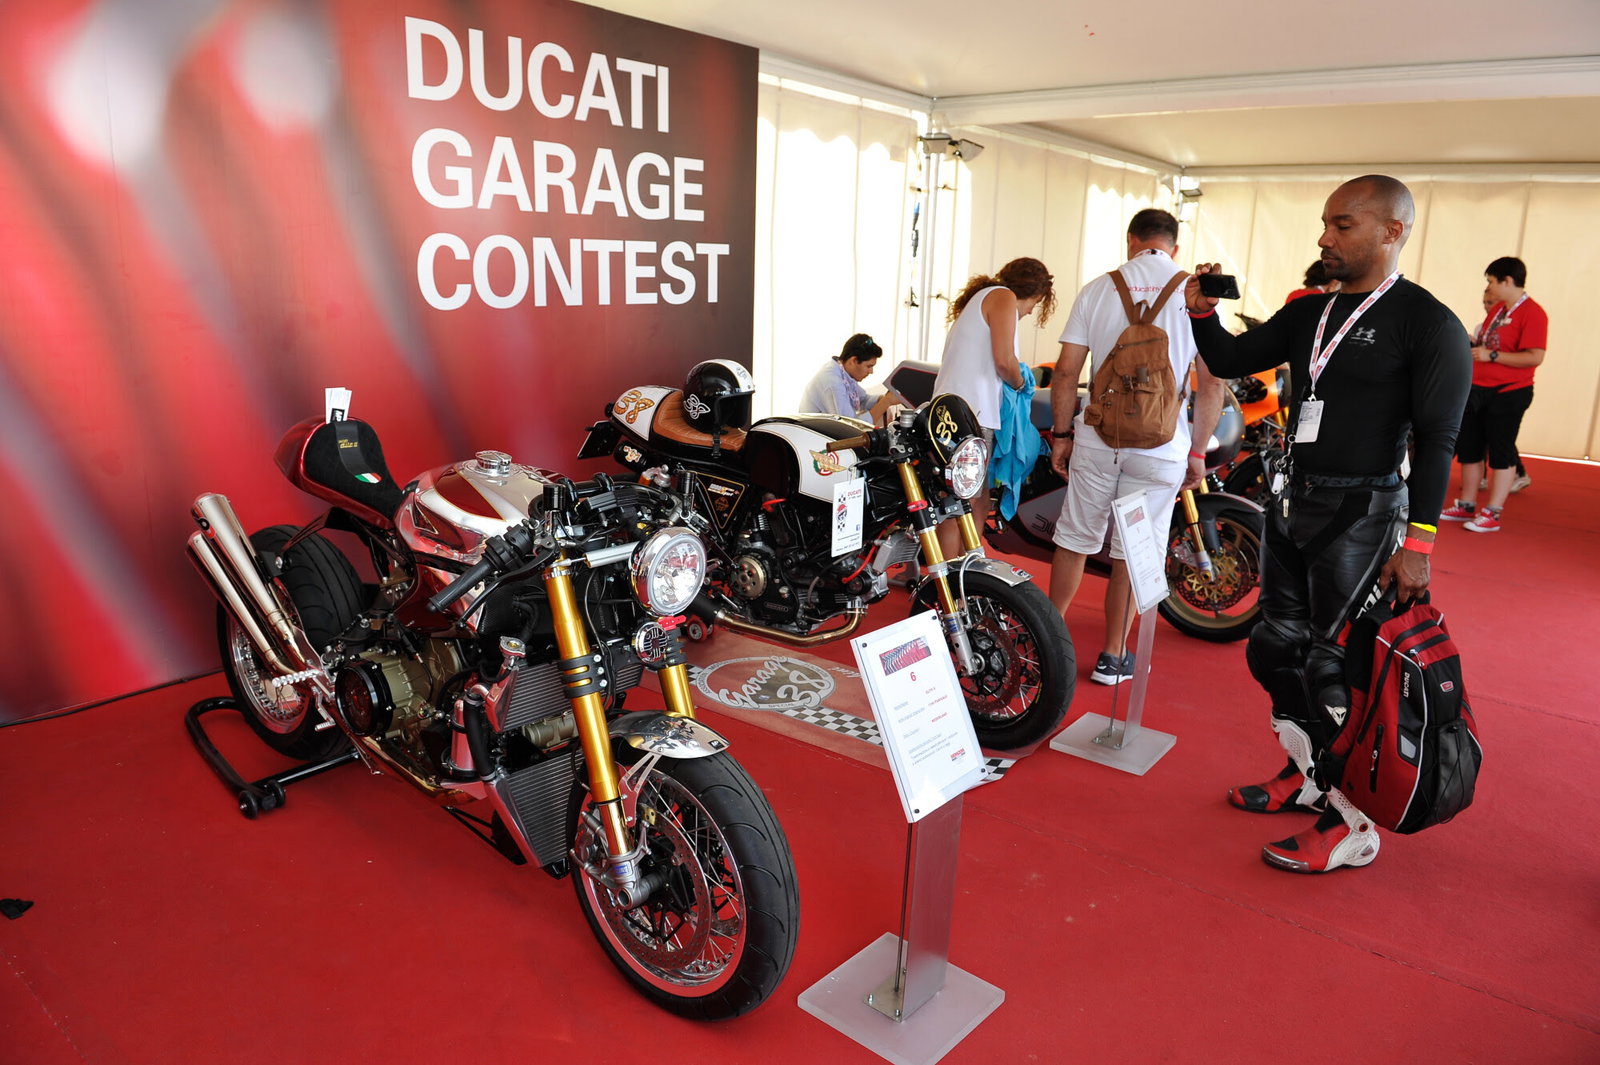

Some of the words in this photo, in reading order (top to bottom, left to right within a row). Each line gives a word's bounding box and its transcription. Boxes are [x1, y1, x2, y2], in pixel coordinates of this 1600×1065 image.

[404, 16, 669, 133] DUCATI
[411, 128, 705, 222] GARAGE
[417, 232, 730, 311] CONTEST
[936, 411, 958, 446] 38
[718, 655, 790, 709] Garage
[776, 669, 832, 708] 38
[909, 671, 917, 682] 6
[1403, 671, 1411, 698] DUCATI
